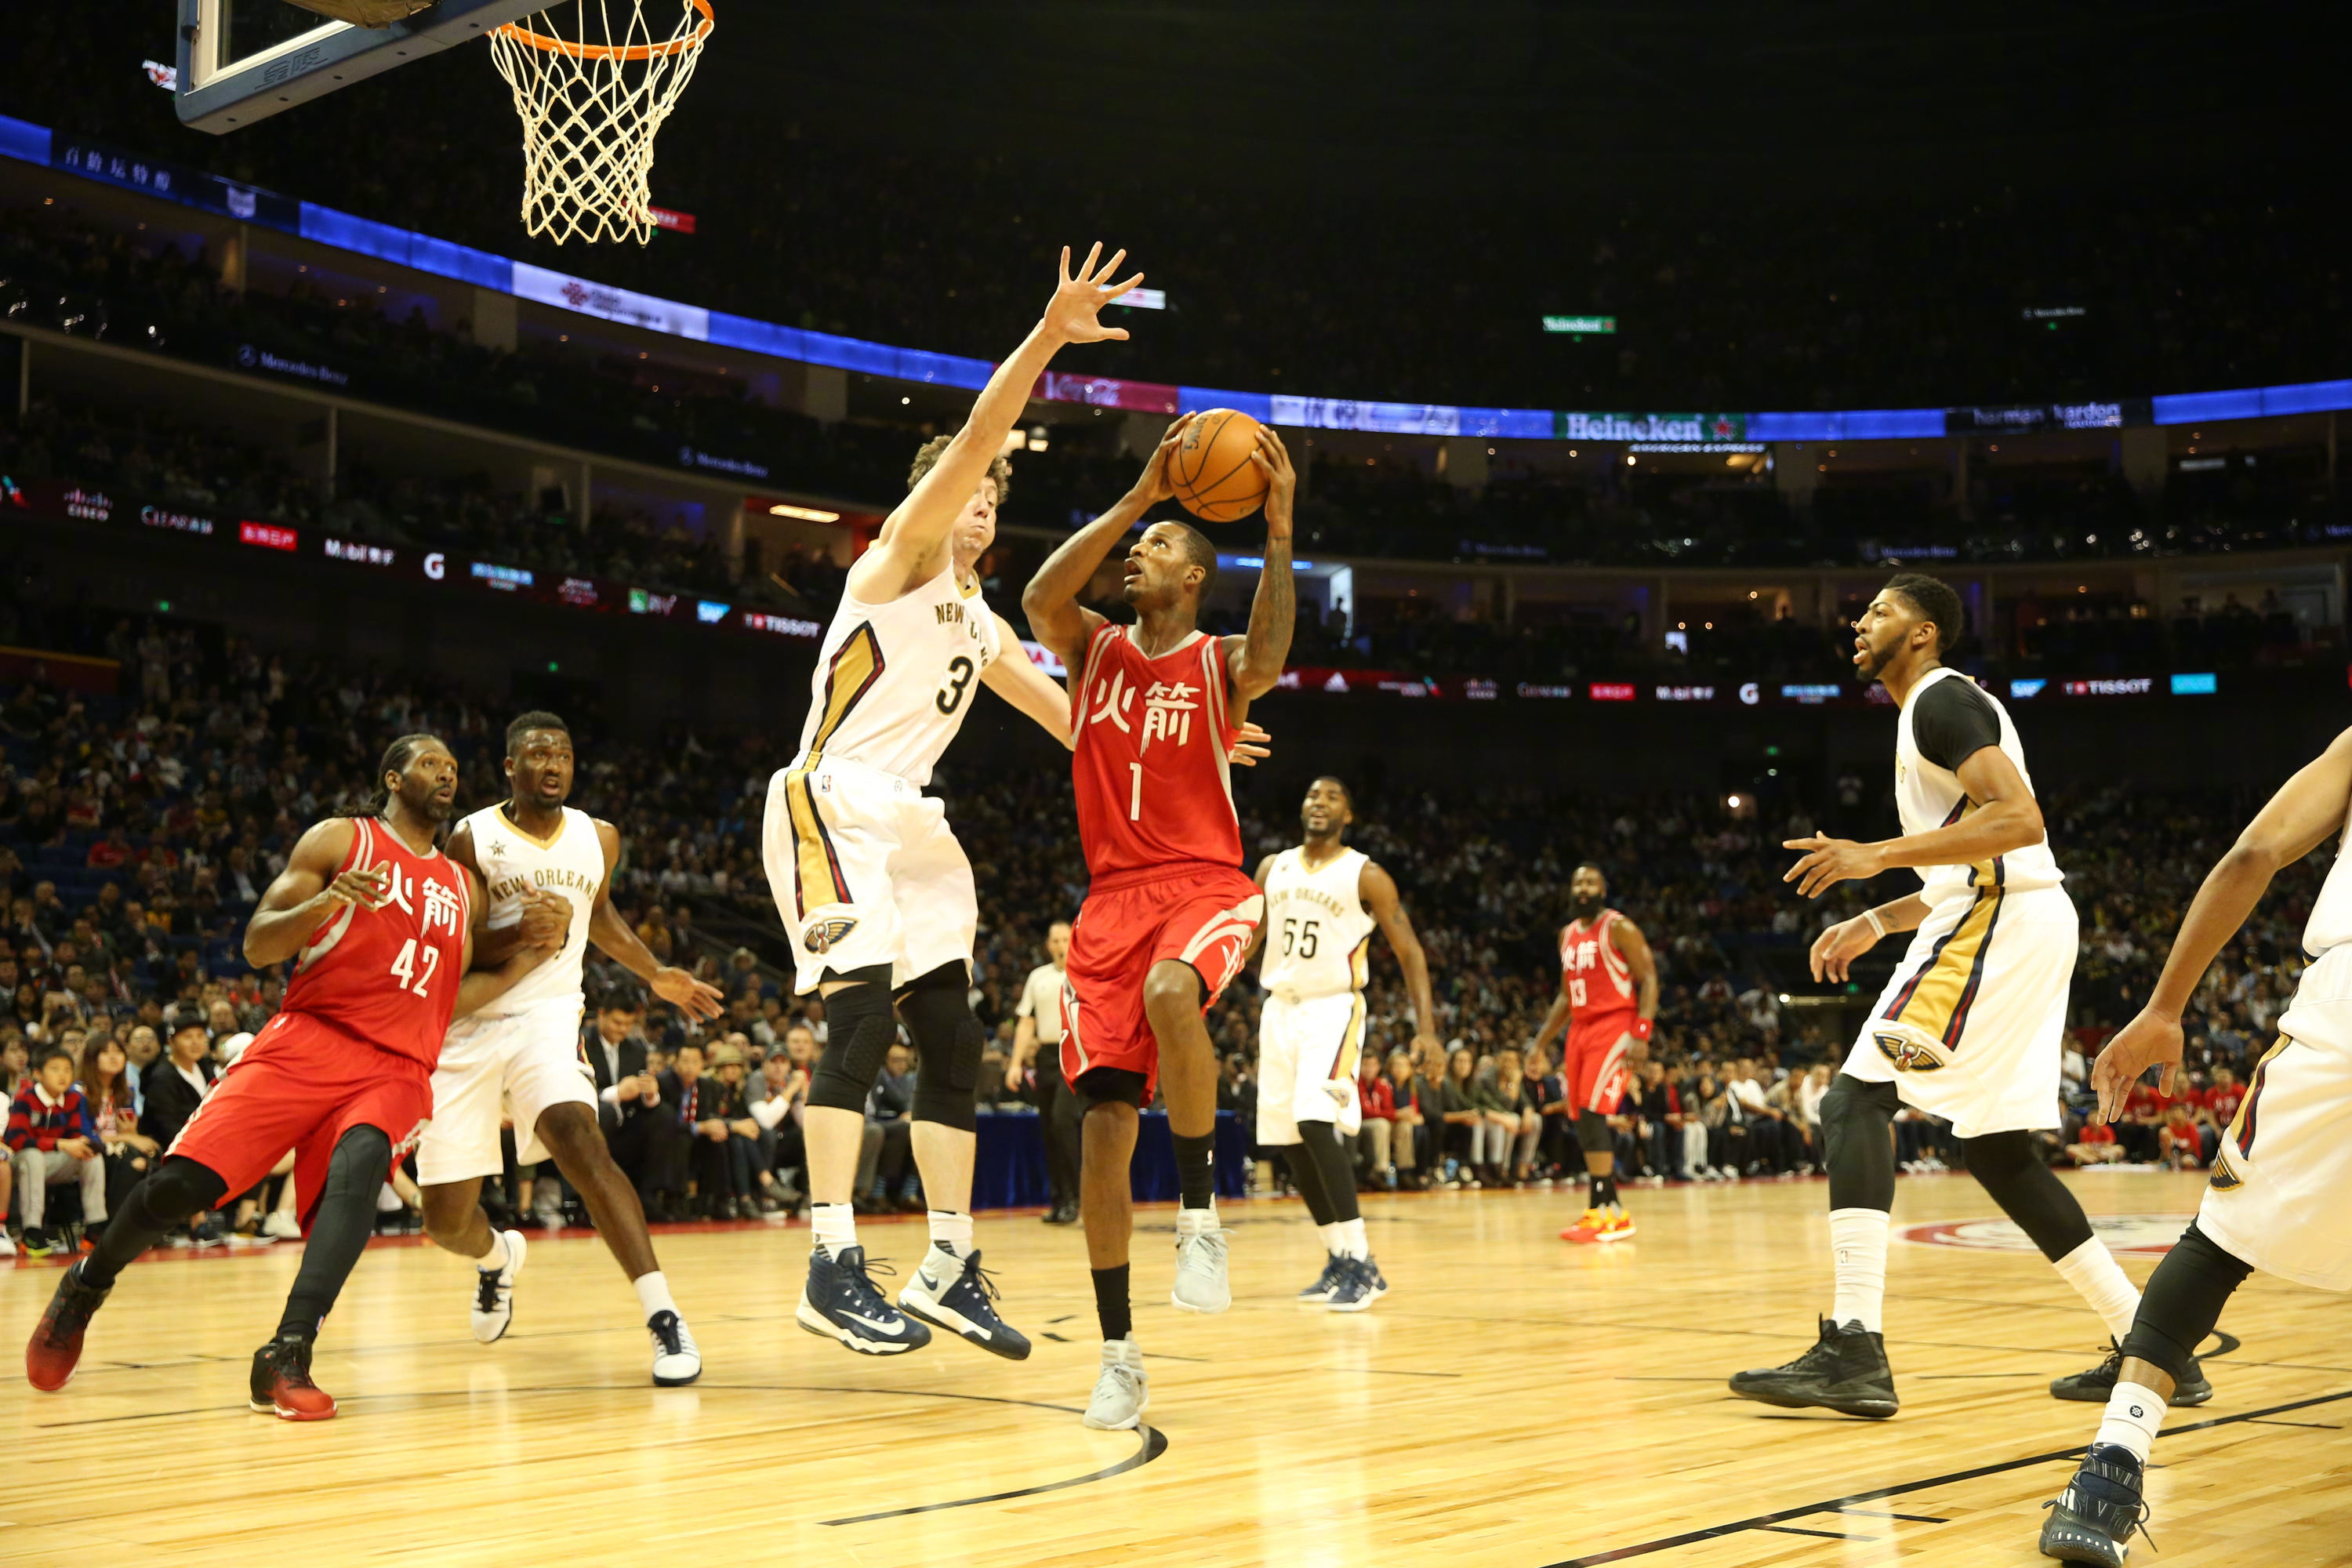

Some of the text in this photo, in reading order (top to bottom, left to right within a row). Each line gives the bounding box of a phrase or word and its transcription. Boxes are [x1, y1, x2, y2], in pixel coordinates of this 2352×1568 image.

[1566, 413, 1704, 441] Heineken
[423, 552, 445, 580] G
[766, 615, 822, 638] TISSOT
[935, 602, 964, 625] NEW
[935, 655, 975, 716] 3
[1739, 682, 1759, 705] G
[2086, 678, 2153, 695] TISSOT
[1090, 668, 1201, 759] 火箭
[1129, 762, 1142, 821] 1
[373, 861, 460, 939] 火箭
[491, 873, 525, 902] NEW
[1295, 887, 1345, 917] ORLEANS
[1283, 918, 1319, 959] 55
[390, 938, 439, 998] 42
